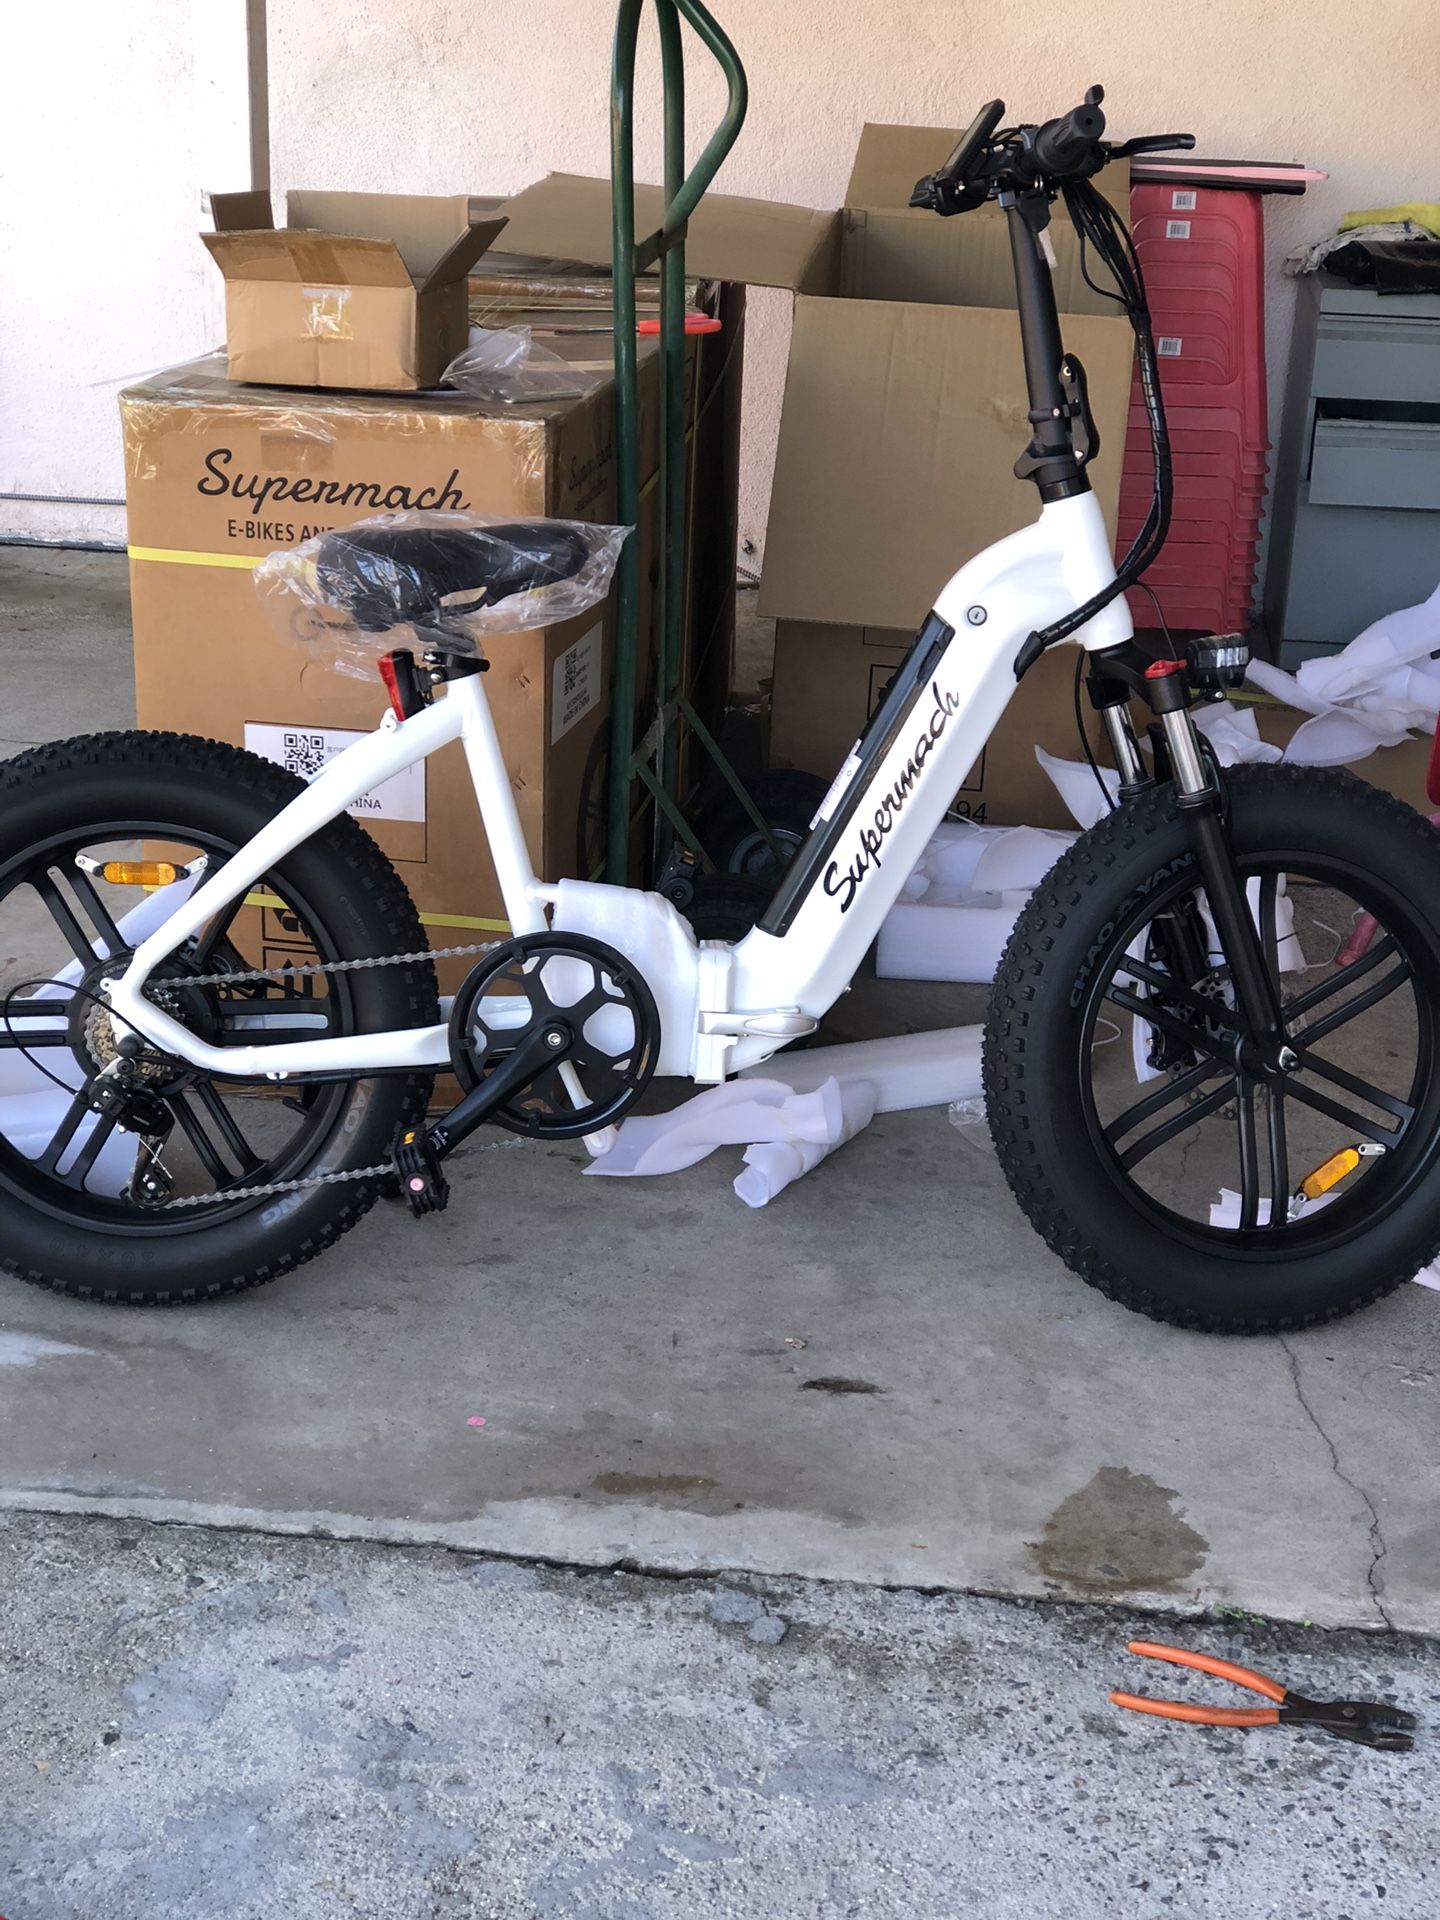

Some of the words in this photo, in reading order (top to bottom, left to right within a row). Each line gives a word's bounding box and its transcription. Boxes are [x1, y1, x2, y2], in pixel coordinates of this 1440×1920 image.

[197, 448, 471, 514] Supermach
[228, 519, 295, 542] E-BIKES
[300, 525, 335, 542] AN
[350, 798, 382, 810] HINA
[822, 681, 960, 913] Supermach
[1069, 921, 1115, 1008] CHAO
[1136, 852, 1195, 894] YAN
